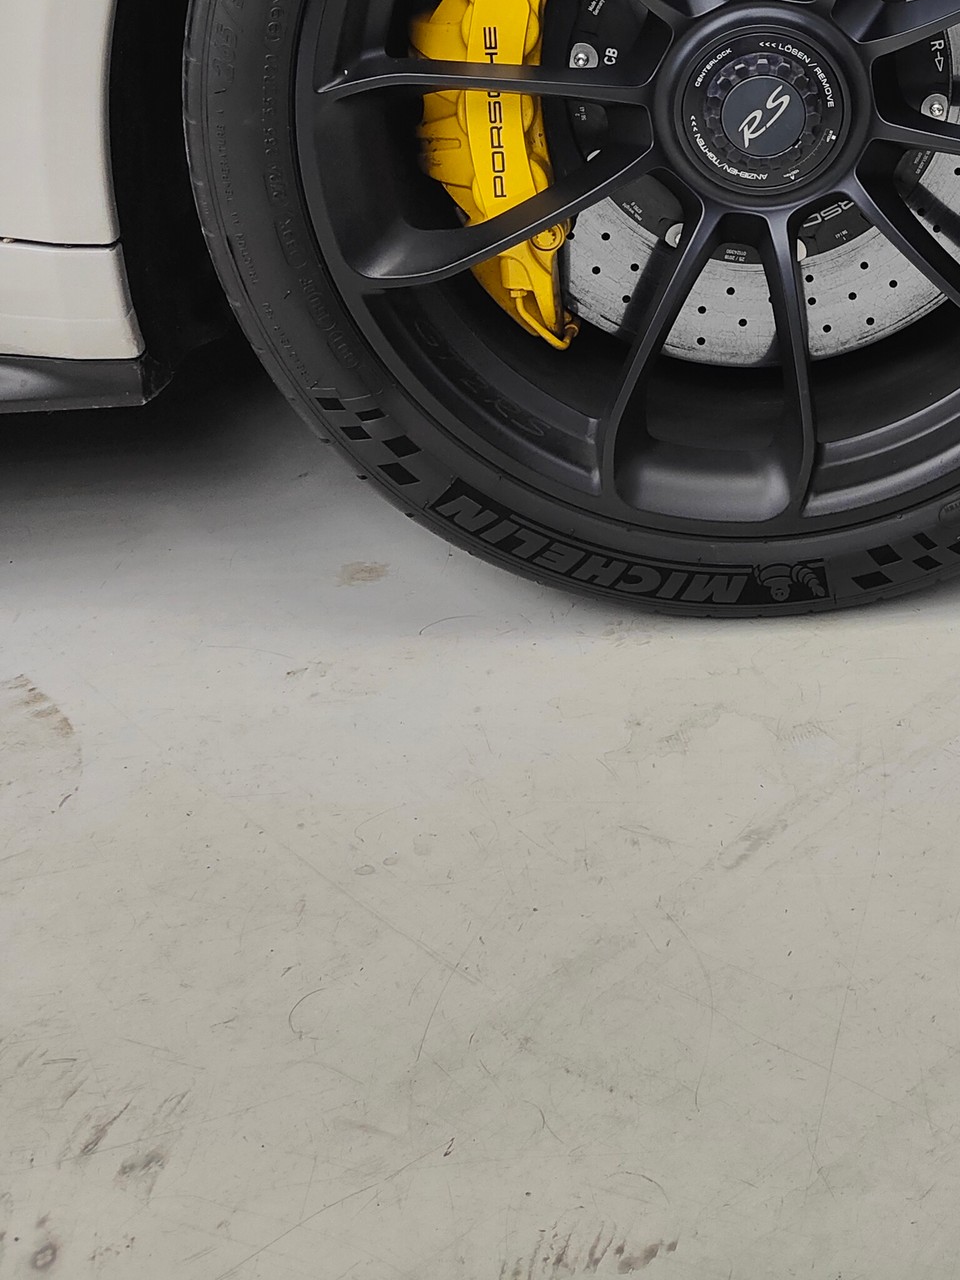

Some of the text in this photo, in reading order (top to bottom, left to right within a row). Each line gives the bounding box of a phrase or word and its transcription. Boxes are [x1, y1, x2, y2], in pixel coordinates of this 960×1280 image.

[603, 47, 618, 65] CB
[694, 47, 732, 87] CENTERLOCK
[778, 43, 811, 67] LÖSEN
[814, 67, 835, 108] REMOVE
[930, 39, 944, 51] R
[483, 26, 507, 198] PORSHE
[738, 84, 791, 149] RS
[435, 494, 748, 604] MICHELIN
